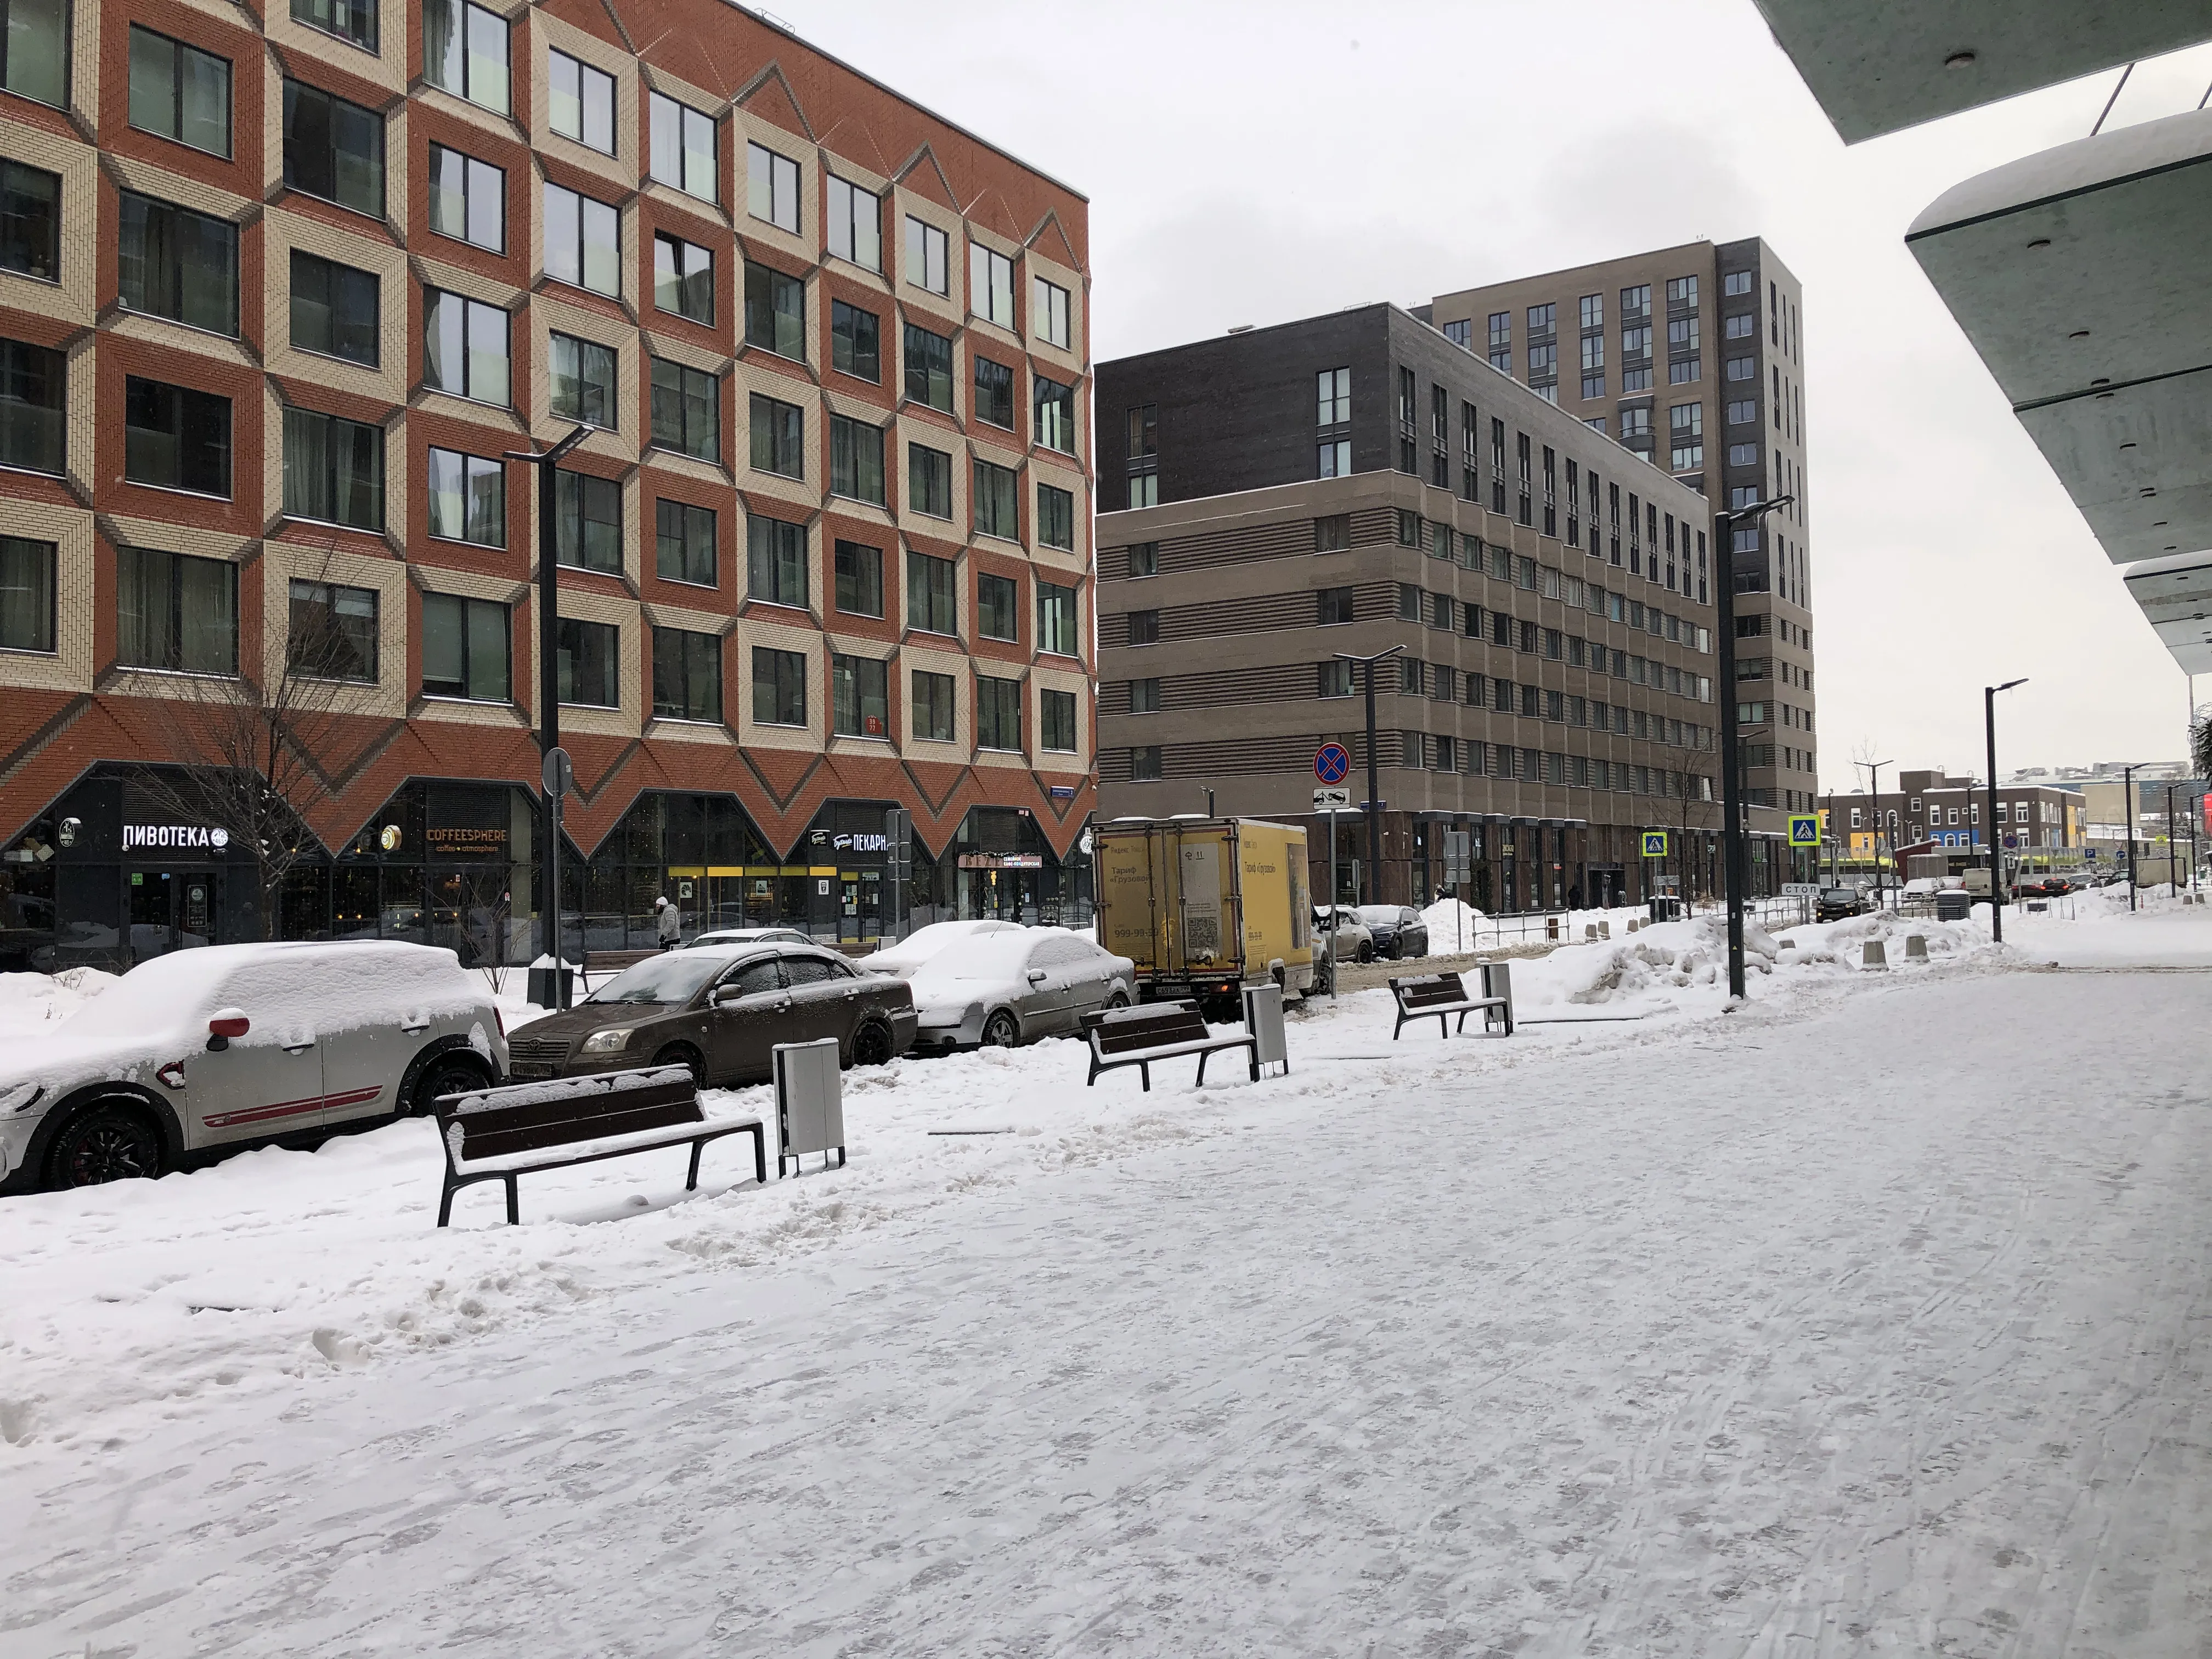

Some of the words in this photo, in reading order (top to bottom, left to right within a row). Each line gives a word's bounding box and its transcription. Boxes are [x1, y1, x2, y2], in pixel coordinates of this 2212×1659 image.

[123, 825, 210, 847] ПИВОТЕКА
[426, 829, 507, 841] COFFEESPHERE
[854, 834, 889, 851] ПЕКАРН
[1111, 867, 1137, 875] Тариф
